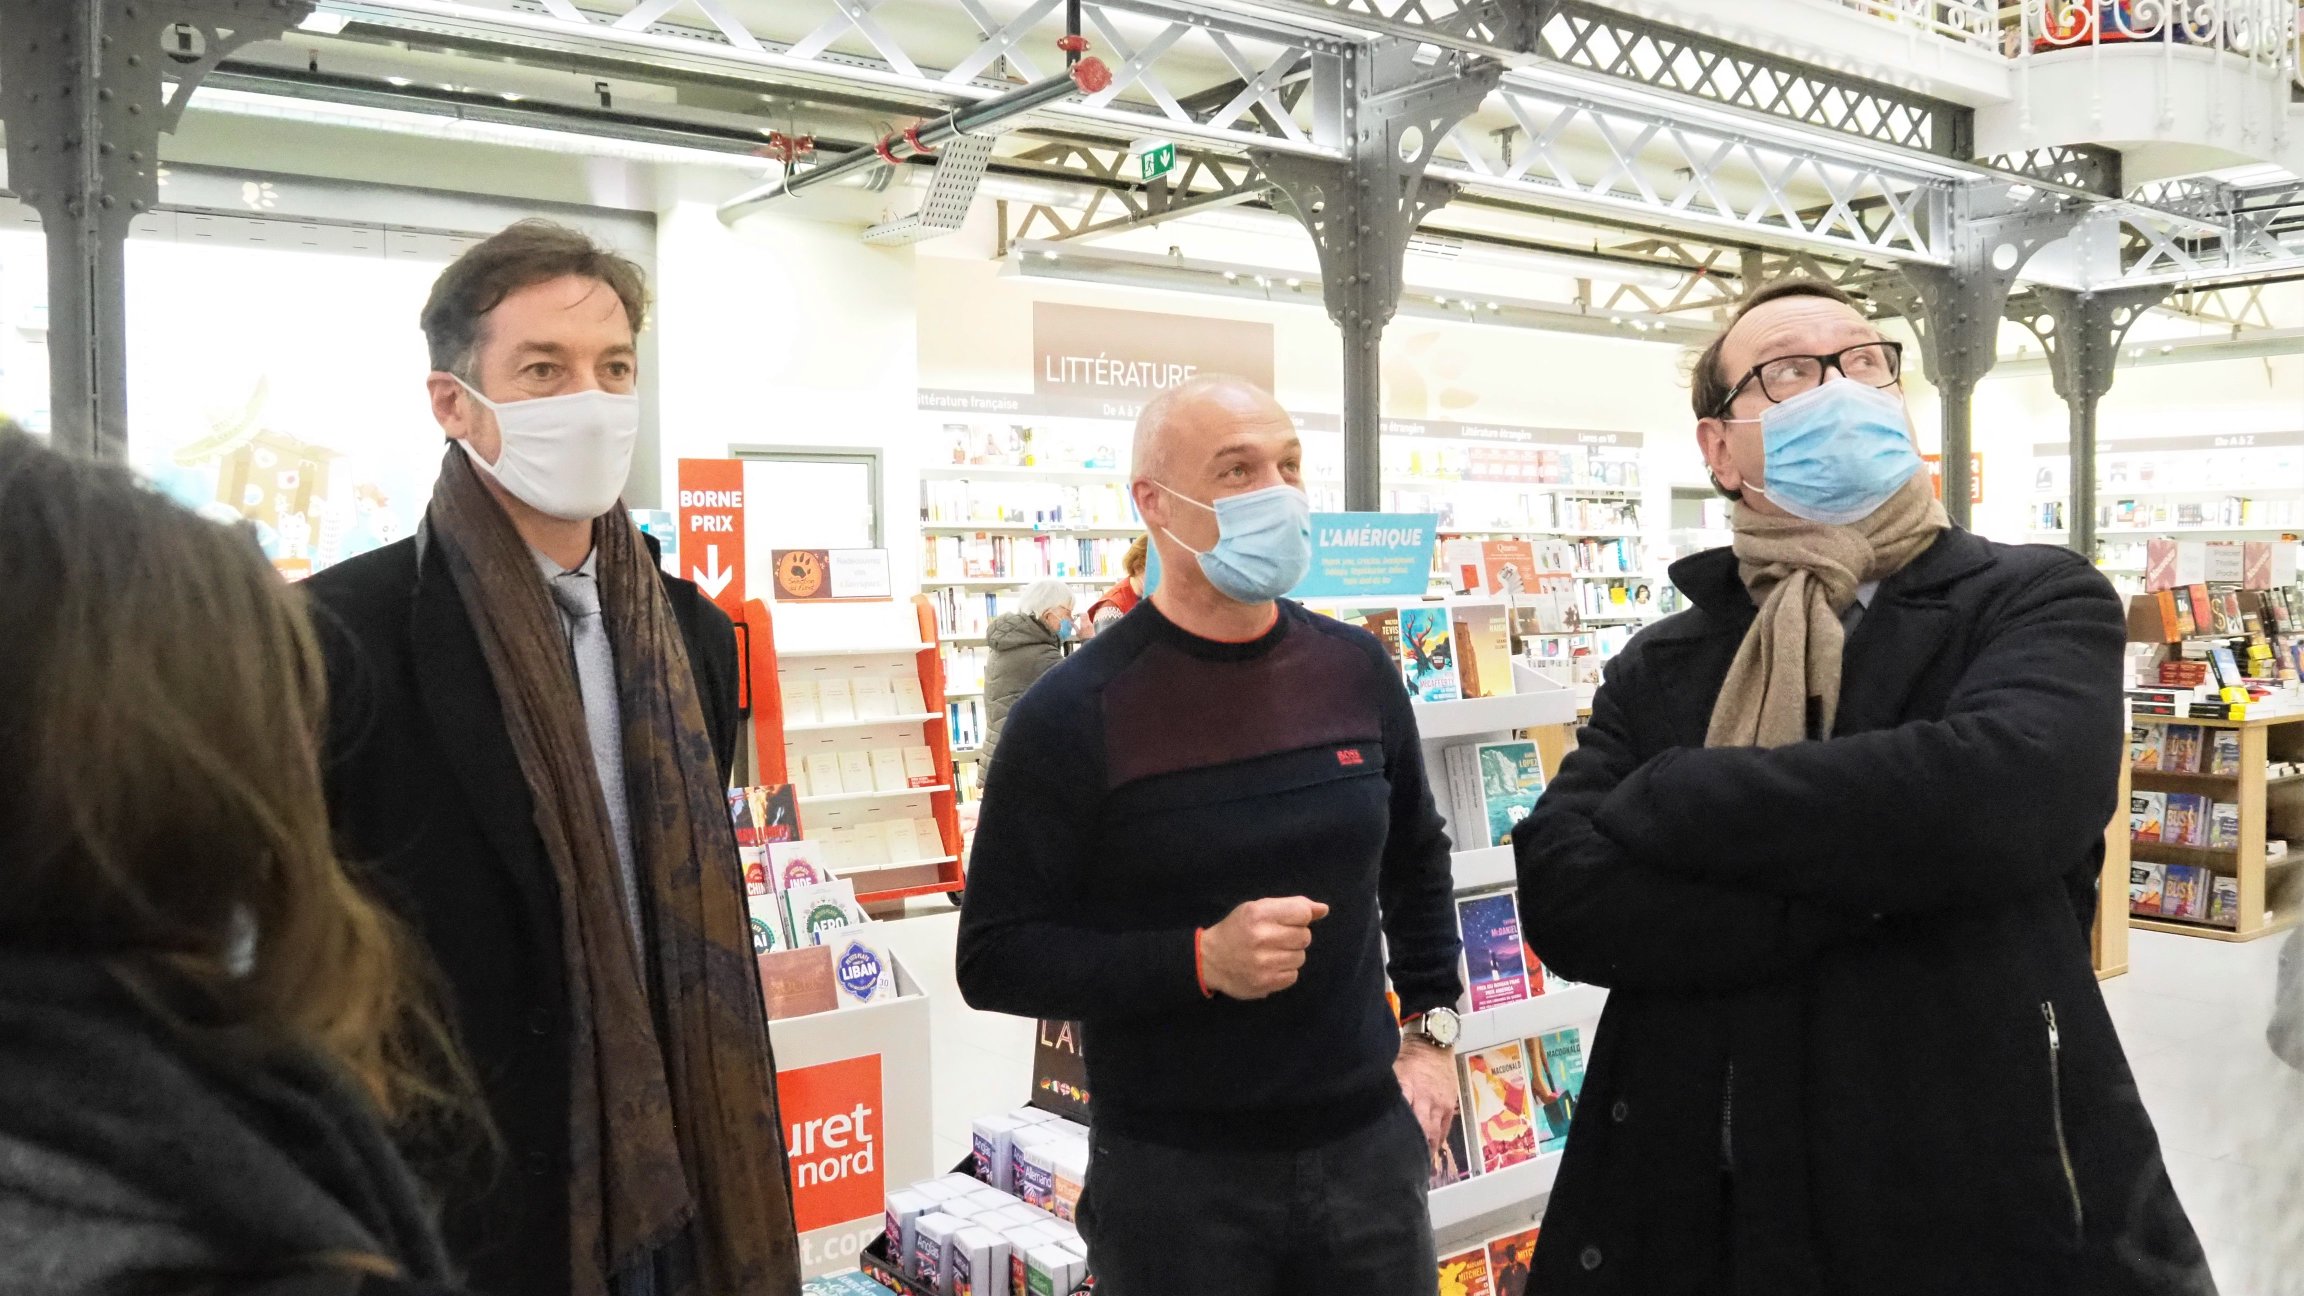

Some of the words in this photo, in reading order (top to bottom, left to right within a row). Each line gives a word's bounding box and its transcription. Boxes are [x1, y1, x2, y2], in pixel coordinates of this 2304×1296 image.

[1045, 352, 1198, 389] LITTÉRATURE
[918, 393, 968, 407] ittérature
[970, 395, 1018, 411] française
[680, 490, 742, 507] BORNE
[691, 515, 733, 532] PRIX
[1320, 523, 1422, 549] L'AMÉRIQUE
[747, 882, 766, 895] CHIN
[753, 931, 768, 947] AÏ
[842, 962, 877, 981] LIBAN
[1491, 1060, 1522, 1075] MACDONALD
[787, 1103, 872, 1159] uret
[798, 1142, 874, 1188] nord
[1025, 1166, 1052, 1188] Allemand
[917, 1235, 939, 1259] Anglais
[1517, 1247, 1534, 1259] MITC
[1458, 1266, 1487, 1280] MITCHELL
